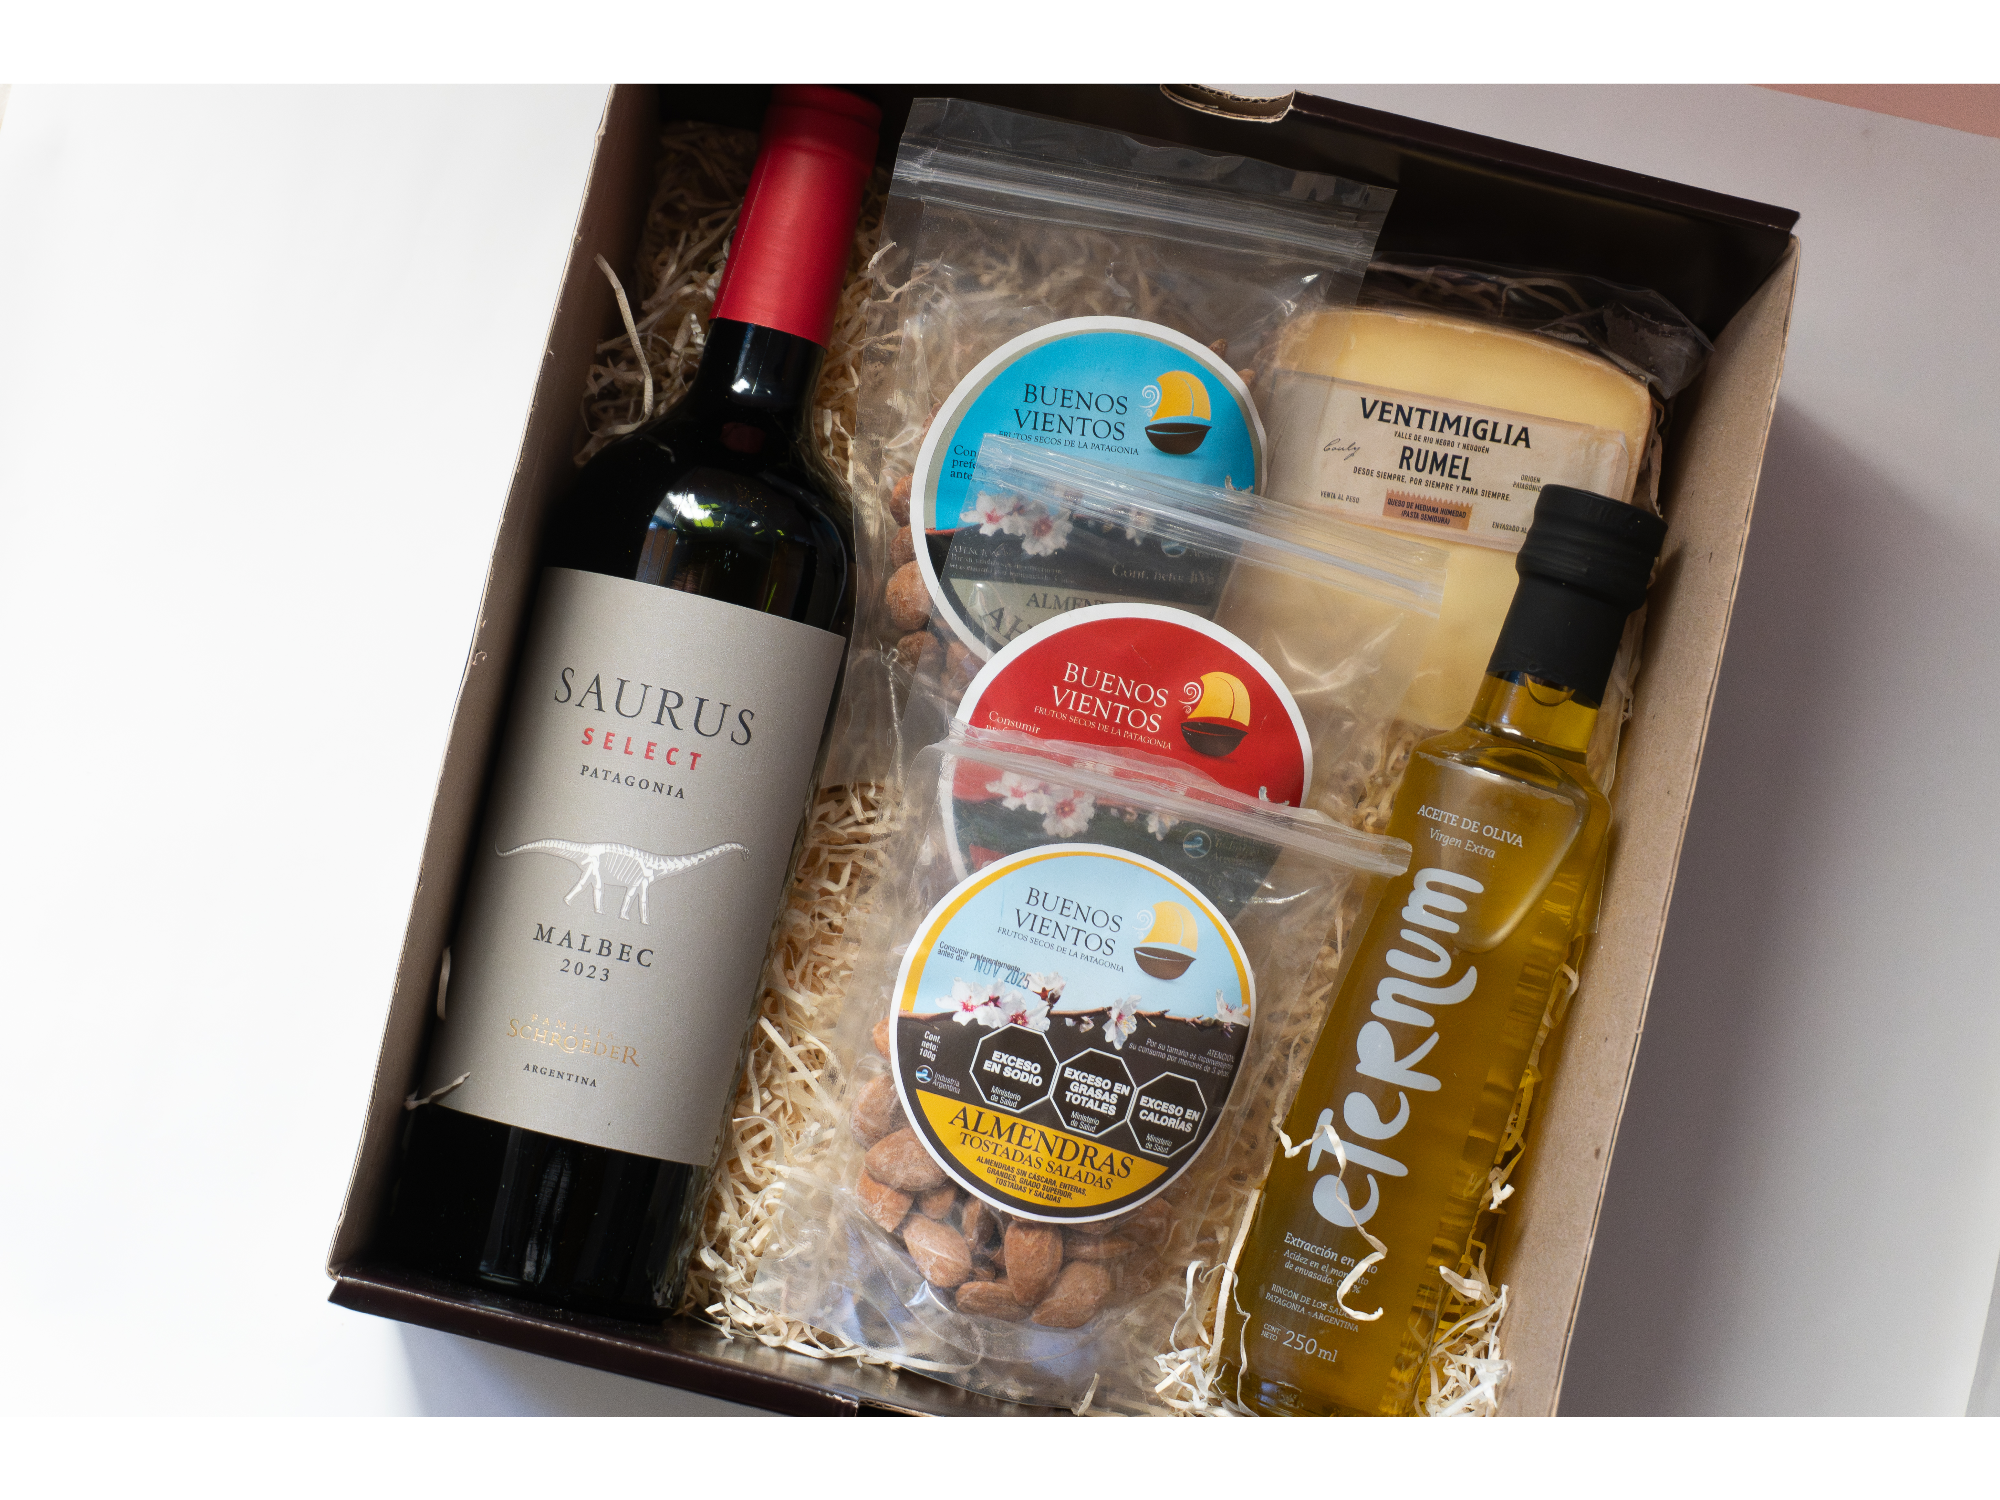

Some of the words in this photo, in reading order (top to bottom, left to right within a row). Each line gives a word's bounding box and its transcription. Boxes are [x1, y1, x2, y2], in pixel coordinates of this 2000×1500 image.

[1023, 383, 1128, 415] BUENOS
[1014, 409, 1125, 441] VIENTOS
[1360, 396, 1532, 449] VENTIMIGLIA
[1034, 435, 1062, 446] SECOS
[1064, 439, 1076, 448] DE
[1078, 441, 1088, 449] LA
[1090, 442, 1139, 456] PATAGONIA
[1394, 430, 1412, 441] VALLE
[1413, 433, 1421, 442] DE
[1435, 438, 1455, 448] NEGRO
[1457, 441, 1461, 449] Y
[1398, 445, 1472, 482] RUMEL
[1353, 466, 1374, 477] DESDE
[1409, 477, 1423, 486] POR
[1424, 480, 1454, 492] SIEMPRE
[1461, 486, 1479, 496] PARA
[1520, 474, 1541, 484] ORIGEN
[1320, 490, 1336, 500] VENTA
[1337, 492, 1345, 501] AL
[1345, 494, 1360, 504] PESO
[1387, 497, 1406, 508] QUESO
[1406, 500, 1414, 509] DE
[1491, 521, 1520, 533] ENVASADO
[1063, 661, 1169, 708] BUENOS
[554, 667, 756, 747] SAURUS
[1052, 685, 1162, 733] VIENTOS
[988, 710, 1041, 734] Consumir
[1034, 705, 1068, 720] FRUTOS
[1068, 715, 1096, 728] SECOS
[1097, 723, 1110, 733] DE
[1111, 726, 1121, 736] LA
[1123, 730, 1172, 750] PATAGONIA
[581, 727, 703, 771] SELECT
[580, 764, 686, 800] PATAGONIA
[1416, 803, 1458, 829] ACEITE
[1460, 815, 1480, 833] DE
[1482, 821, 1525, 849] OLIVA
[1429, 827, 1463, 851] Virgen
[1464, 838, 1496, 860] Extra
[1025, 886, 1123, 933] BUENOS
[1015, 908, 1116, 956] VIENTOS
[533, 923, 655, 969] MALBEC
[937, 948, 955, 960] antes
[955, 955, 966, 963] de:
[939, 941, 969, 957] Consumir
[970, 952, 1021, 972] preferentemente
[997, 926, 1028, 942] FRUTOS
[1029, 937, 1055, 950] SECOS
[1056, 945, 1067, 954] DE
[1068, 949, 1078, 958] LA
[1080, 953, 1124, 973] PATAGONIA
[559, 958, 611, 983] 2023
[974, 957, 1001, 978] NOV
[1004, 969, 1031, 990] 2025
[507, 1018, 640, 1067] SCHROEDER
[921, 1040, 939, 1052] neto:
[924, 1030, 941, 1043] Cont.
[1146, 1037, 1157, 1048] Por
[1157, 1043, 1166, 1051] su
[920, 1047, 936, 1062] 100g
[991, 1050, 1042, 1074] EXCESO
[1129, 1042, 1137, 1050] su
[1138, 1045, 1167, 1060] consumo
[1166, 1053, 1177, 1062] por
[1177, 1057, 1202, 1070] menores
[1203, 1064, 1211, 1073] de
[523, 1063, 597, 1088] ARGENTINA
[934, 1071, 960, 1087] Industria
[982, 1059, 1002, 1075] EN
[1002, 1066, 1043, 1087] SODIO
[1063, 1066, 1112, 1090] EXCESO
[1113, 1082, 1131, 1096] EN
[932, 1079, 961, 1095] Argentina
[991, 1085, 1022, 1101] Ministerio
[1069, 1081, 1119, 1105] GRASAS
[990, 1094, 999, 1102] de
[999, 1097, 1018, 1108] Salud
[1065, 1091, 1117, 1116] TOTALES
[1139, 1095, 1184, 1117] EXCESO
[1184, 1108, 1201, 1121] EN
[1070, 1110, 1100, 1126] Ministerio
[1070, 1119, 1078, 1128] de
[1079, 1121, 1097, 1132] Salud
[1139, 1109, 1193, 1133] CALORÍAS
[948, 1106, 1134, 1179] ALMENDRAS
[1145, 1133, 1173, 1147] Ministerio
[1145, 1141, 1153, 1149] de
[1153, 1143, 1169, 1154] Salud
[959, 1132, 1044, 1170] TOSTADAS
[1045, 1161, 1114, 1190] SALADAS
[976, 1155, 1016, 1173] ALMENDRAS
[1016, 1165, 1028, 1176] SIN
[1059, 1179, 1087, 1196] ENTERAS,
[986, 1166, 1017, 1183] GRANDES,
[1019, 1177, 1041, 1190] GRADO
[1042, 1184, 1073, 1201] SUPERIOR,
[995, 1177, 1027, 1193] TOSTADAS
[1034, 1189, 1062, 1204] SALADAS
[1283, 1231, 1338, 1262] Extracción
[1340, 1255, 1355, 1268] en
[1283, 1249, 1308, 1265] Acidez
[1309, 1260, 1320, 1269] en
[1320, 1263, 1329, 1273] el
[1284, 1260, 1294, 1270] de
[1294, 1266, 1335, 1285] envasado:
[1271, 1283, 1299, 1301] RINCÓN
[1299, 1295, 1312, 1305] DE
[1311, 1299, 1328, 1311] LOS
[1265, 1291, 1305, 1315] PATAGONIA
[1312, 1311, 1359, 1333] ARGENTINA
[1261, 1330, 1278, 1341] NETO
[1282, 1330, 1318, 1355] 250
[1317, 1347, 1338, 1363] ml
